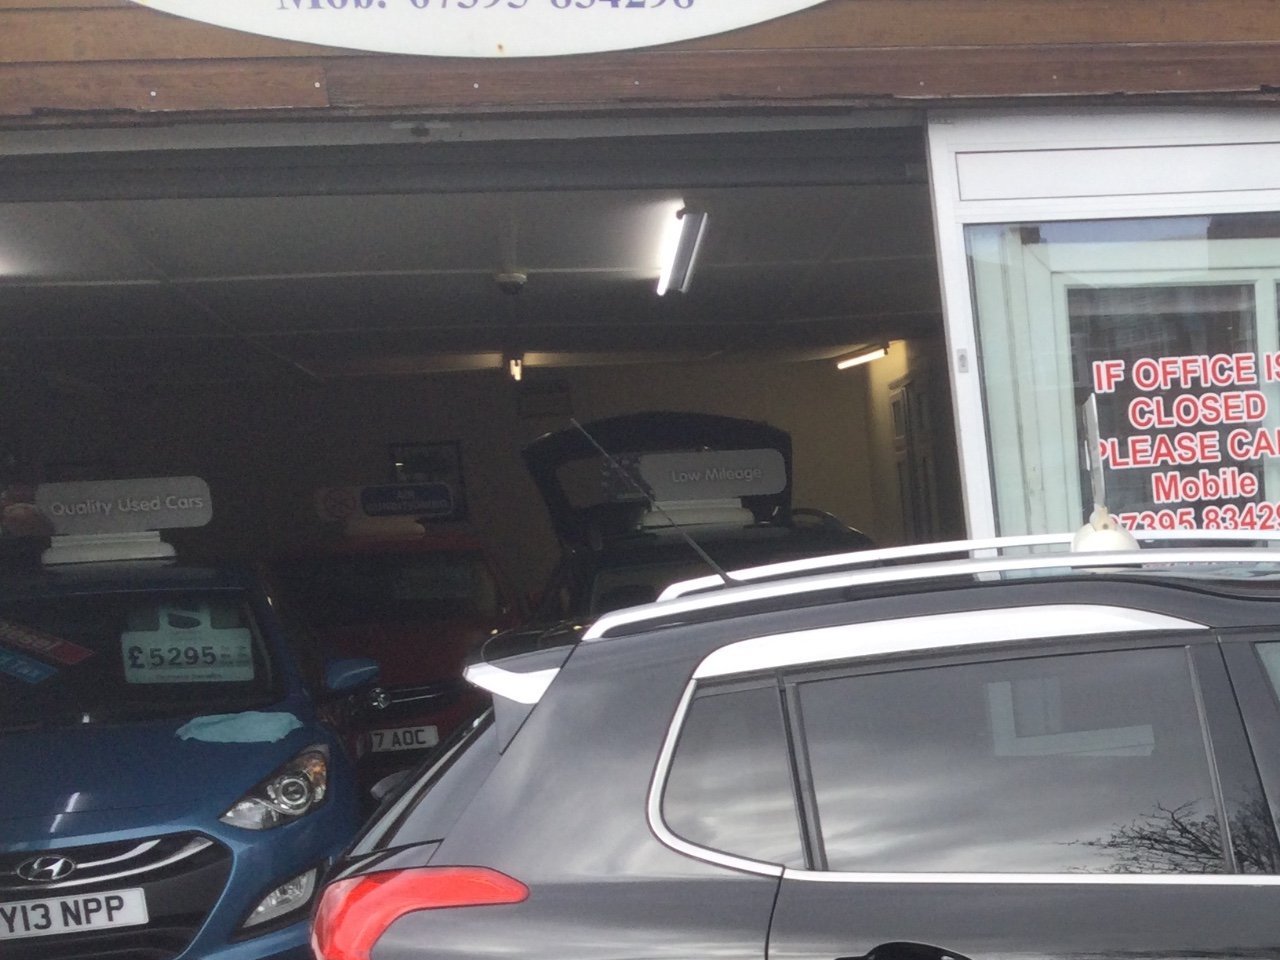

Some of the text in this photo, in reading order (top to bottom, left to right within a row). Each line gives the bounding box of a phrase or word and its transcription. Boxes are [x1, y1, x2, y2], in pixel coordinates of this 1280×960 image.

[1093, 361, 1124, 392] IF
[1133, 352, 1257, 390] OFFICE
[1128, 391, 1267, 429] CLOSED
[672, 466, 763, 482] Low Mileage
[1152, 468, 1259, 503] Mobile
[51, 495, 203, 516] Quality Used Cars
[1109, 507, 1197, 531] 7395
[392, 729, 427, 747] AOC
[60, 895, 125, 927] NPP
